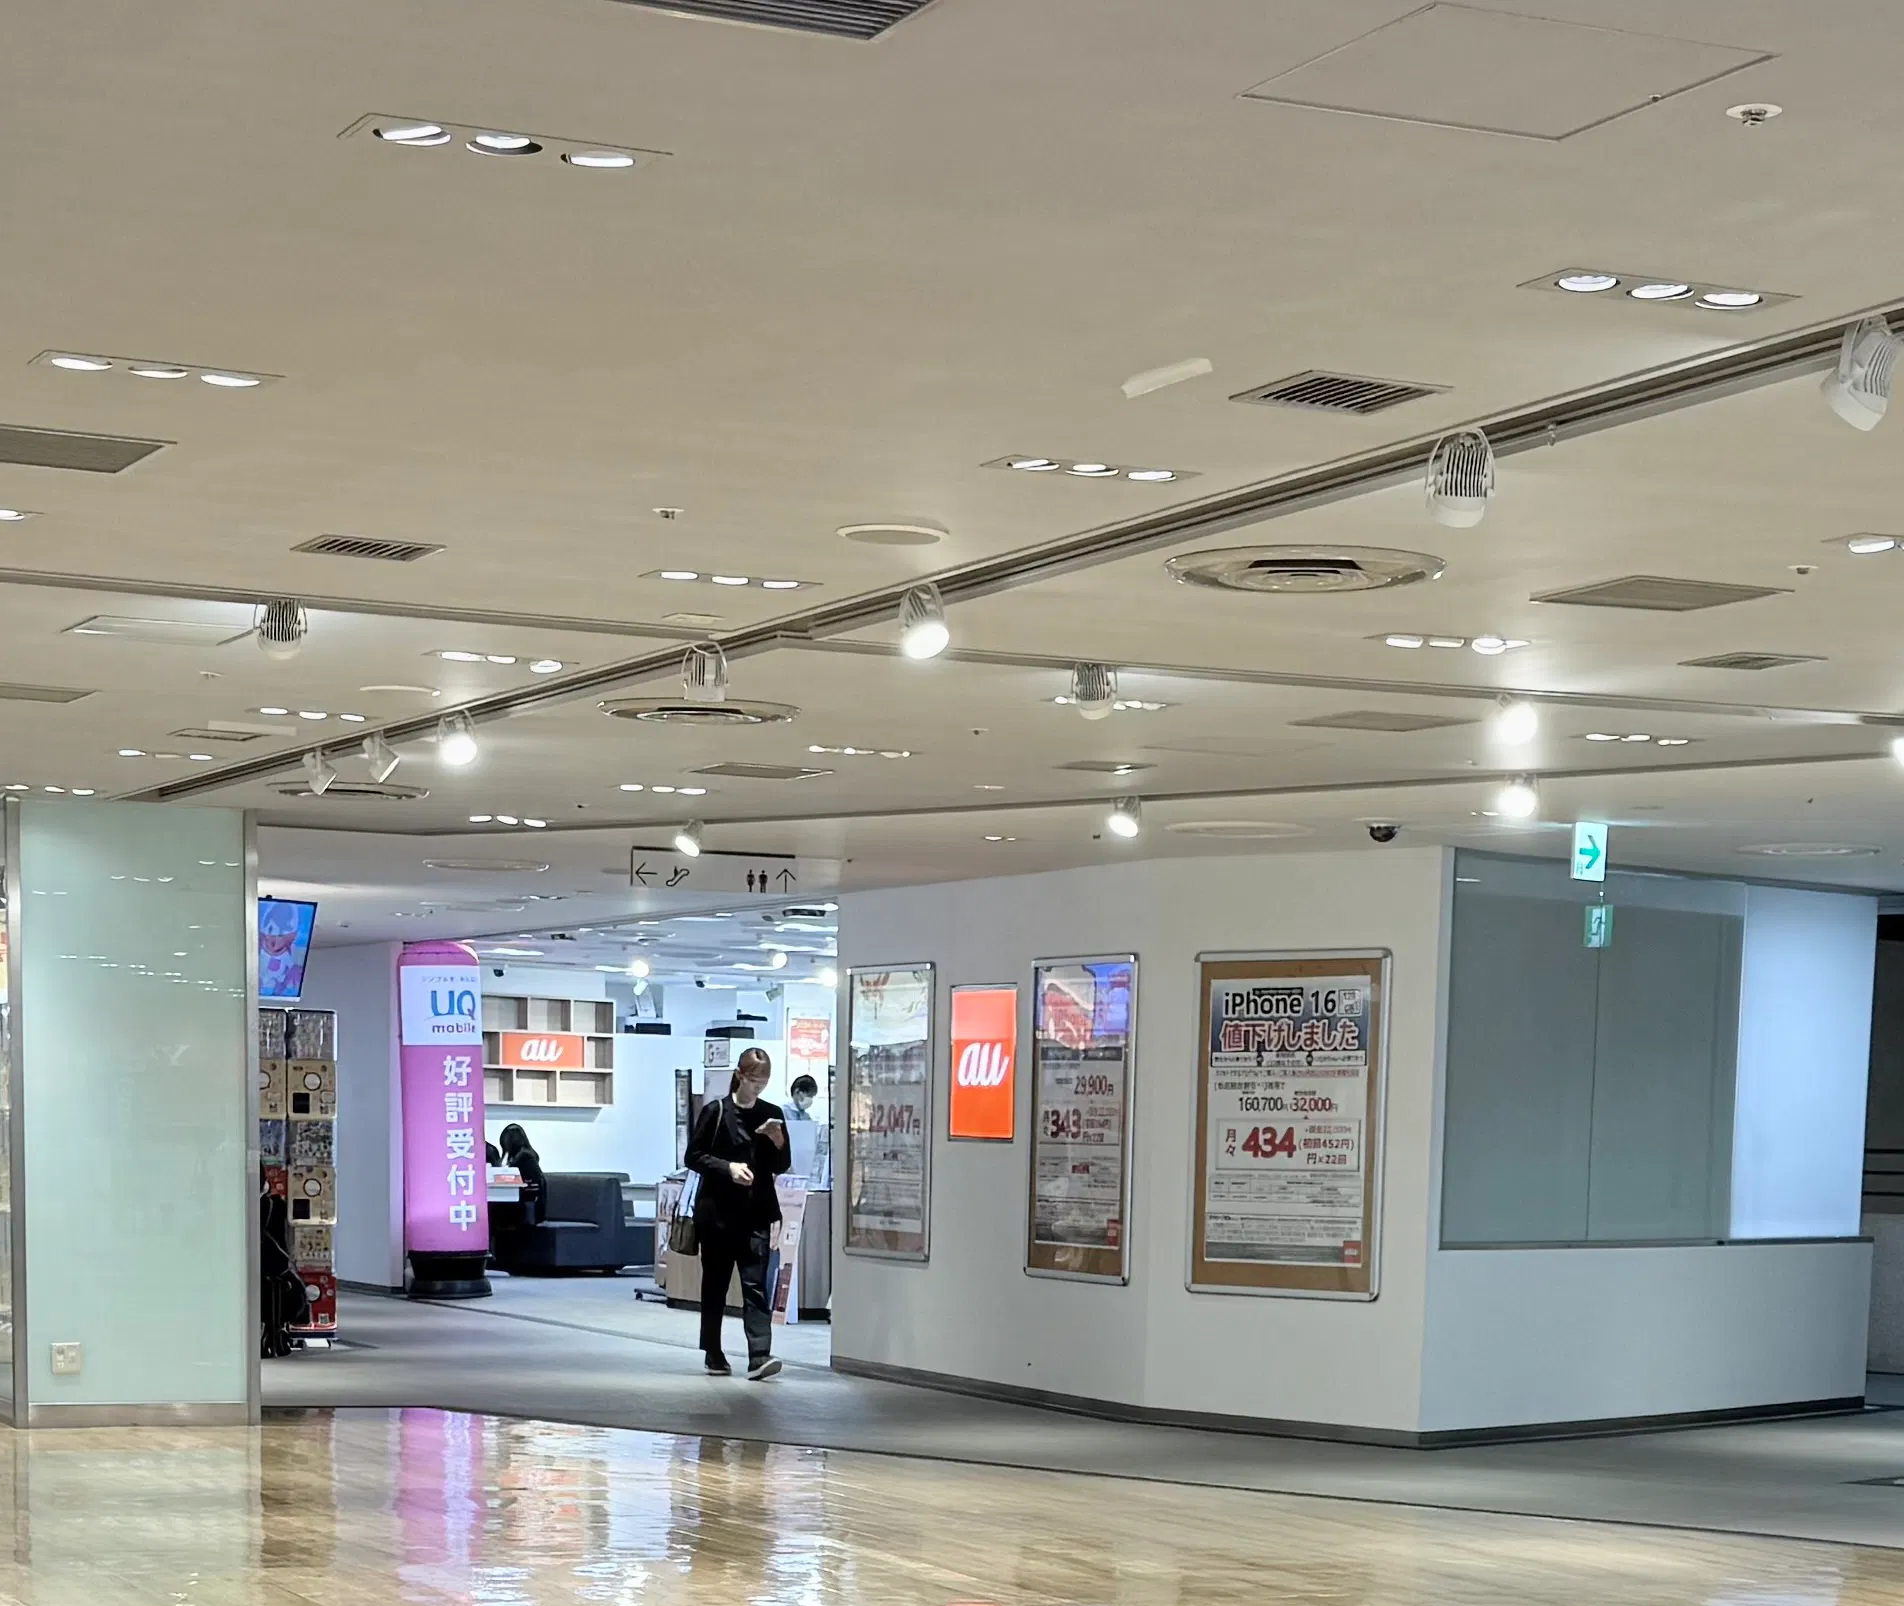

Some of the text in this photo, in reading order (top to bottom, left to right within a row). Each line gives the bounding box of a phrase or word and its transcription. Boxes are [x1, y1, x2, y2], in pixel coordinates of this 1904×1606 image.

[431, 990, 476, 1020] UQ
[1224, 990, 1337, 1016] iPhone 16
[520, 1038, 563, 1062] au
[1222, 1019, 1359, 1051] 値下げしました
[958, 1042, 1010, 1086] au
[443, 1055, 477, 1232] 好評受付中
[1241, 1126, 1297, 1159] 434
